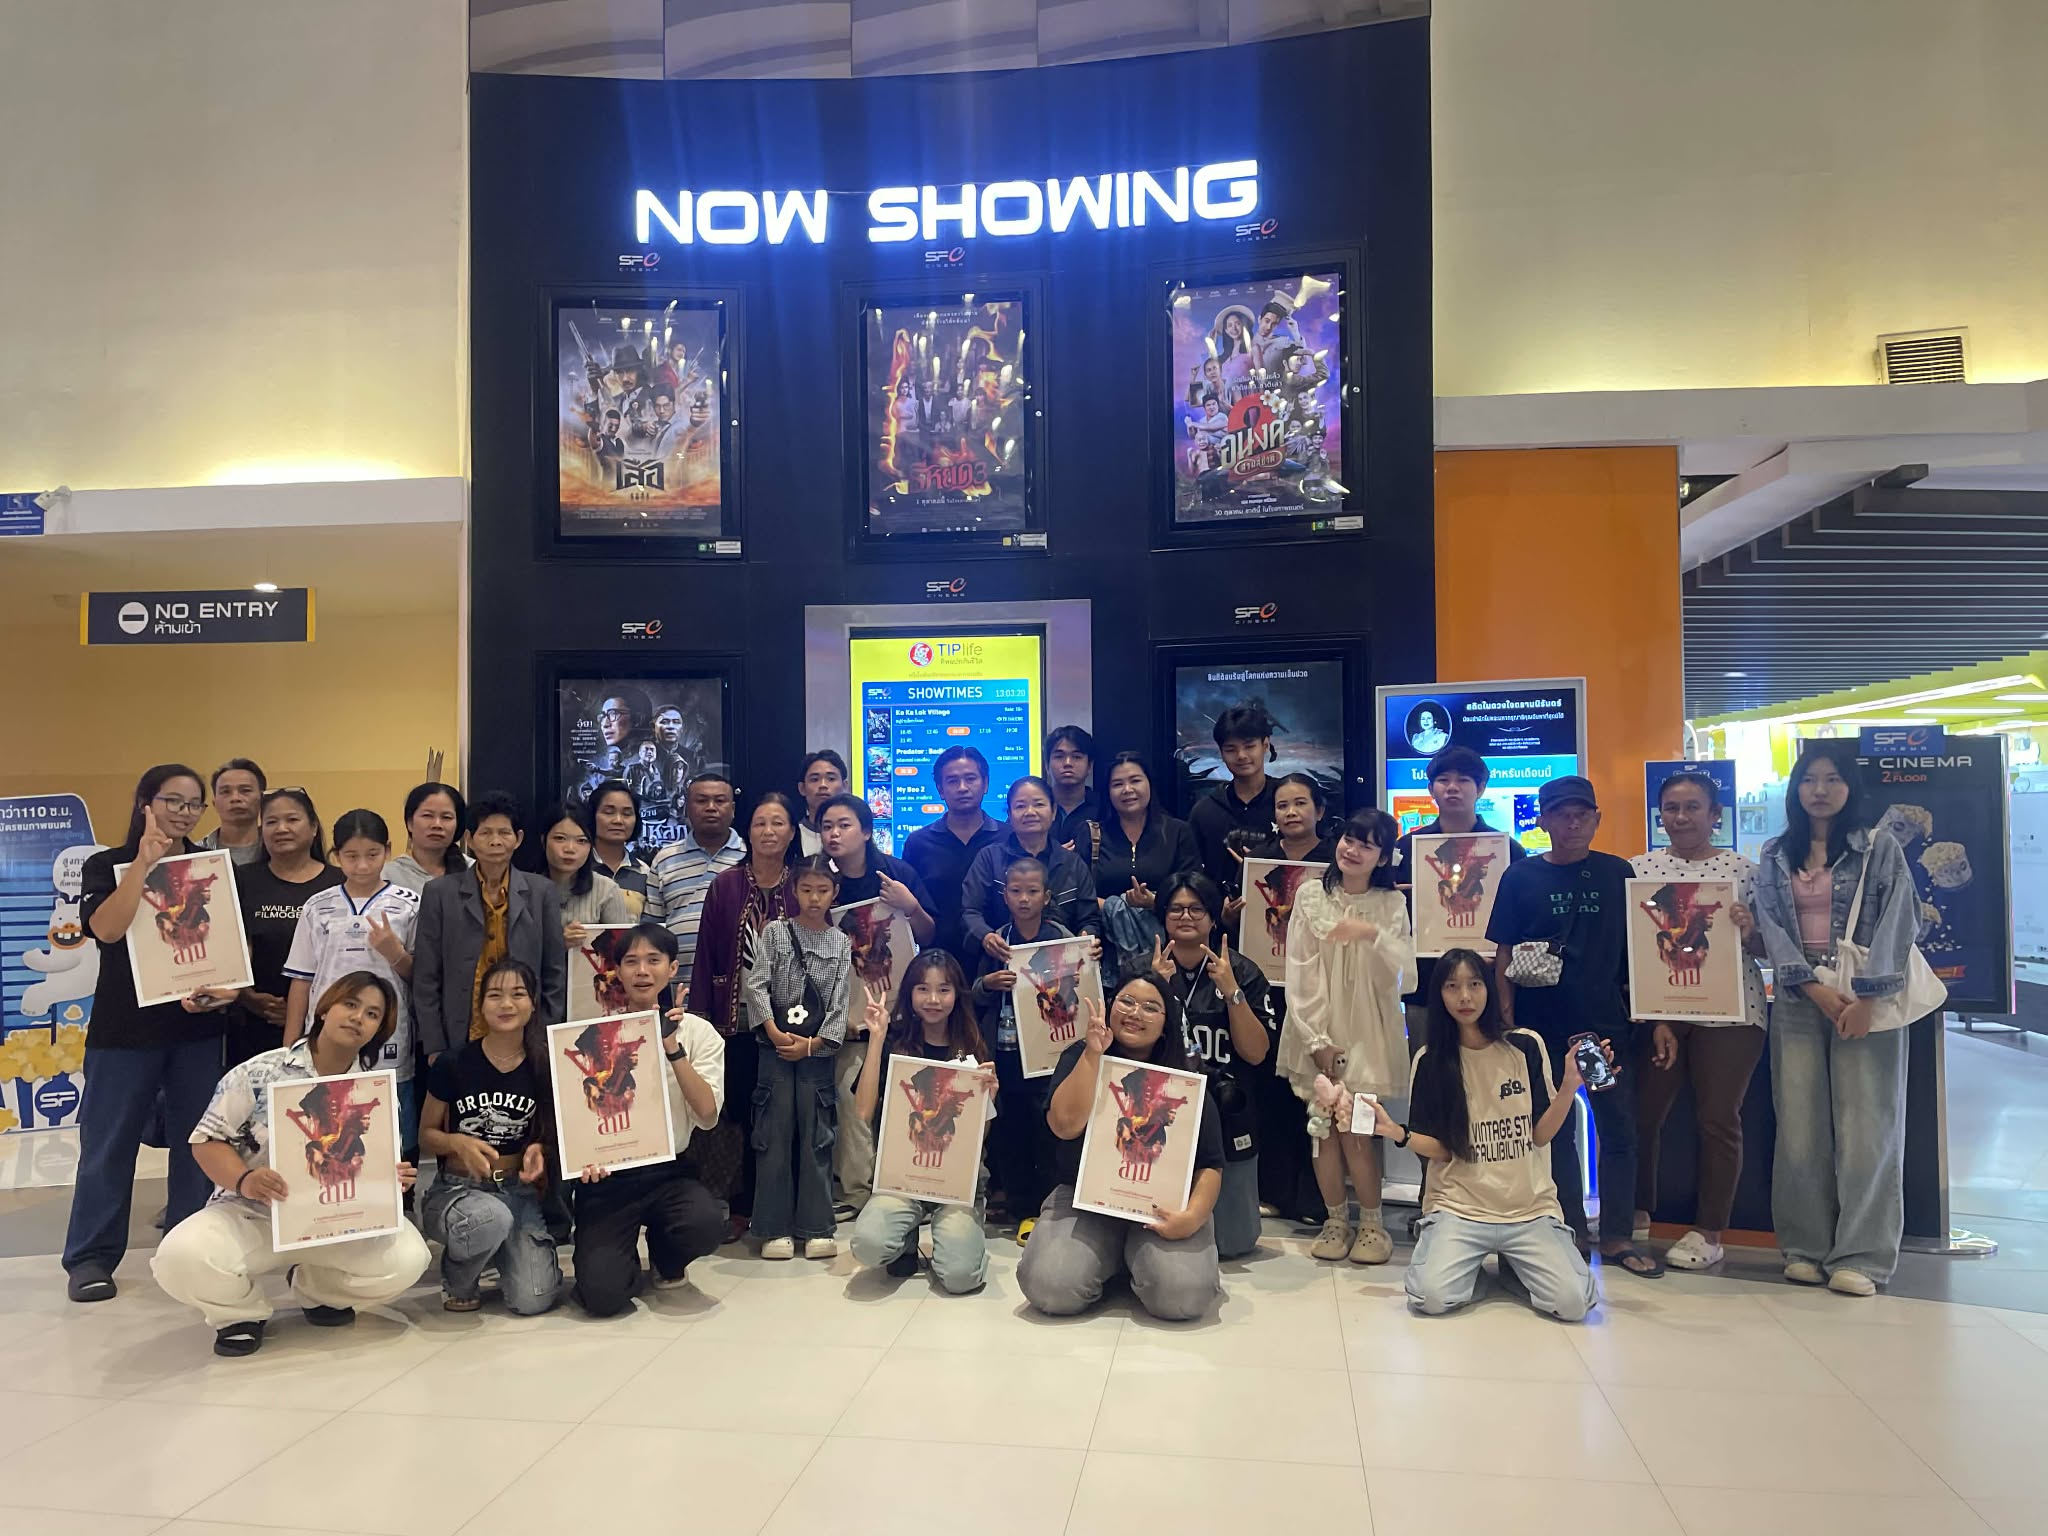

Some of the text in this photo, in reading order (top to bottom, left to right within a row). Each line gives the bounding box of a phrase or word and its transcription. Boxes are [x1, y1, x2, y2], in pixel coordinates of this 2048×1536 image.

[636, 160, 1258, 244] NOW SHOWING
[155, 601, 278, 619] NO ENTRY
[154, 619, 201, 635] ห้ามเข้า
[908, 686, 983, 699] SHOWTIMES
[927, 709, 951, 717] Village
[1879, 756, 1973, 769] CINEMA
[1489, 765, 1552, 779] สำหรับเดือนนี้
[1882, 770, 1927, 783] 2 FLOOR
[896, 786, 906, 794] My
[49, 806, 73, 816] ช.ม.
[40, 1091, 76, 1109] SF
[1472, 1117, 1513, 1143] VINTAGE
[1468, 1139, 1525, 1164] NFALLIBILITY
